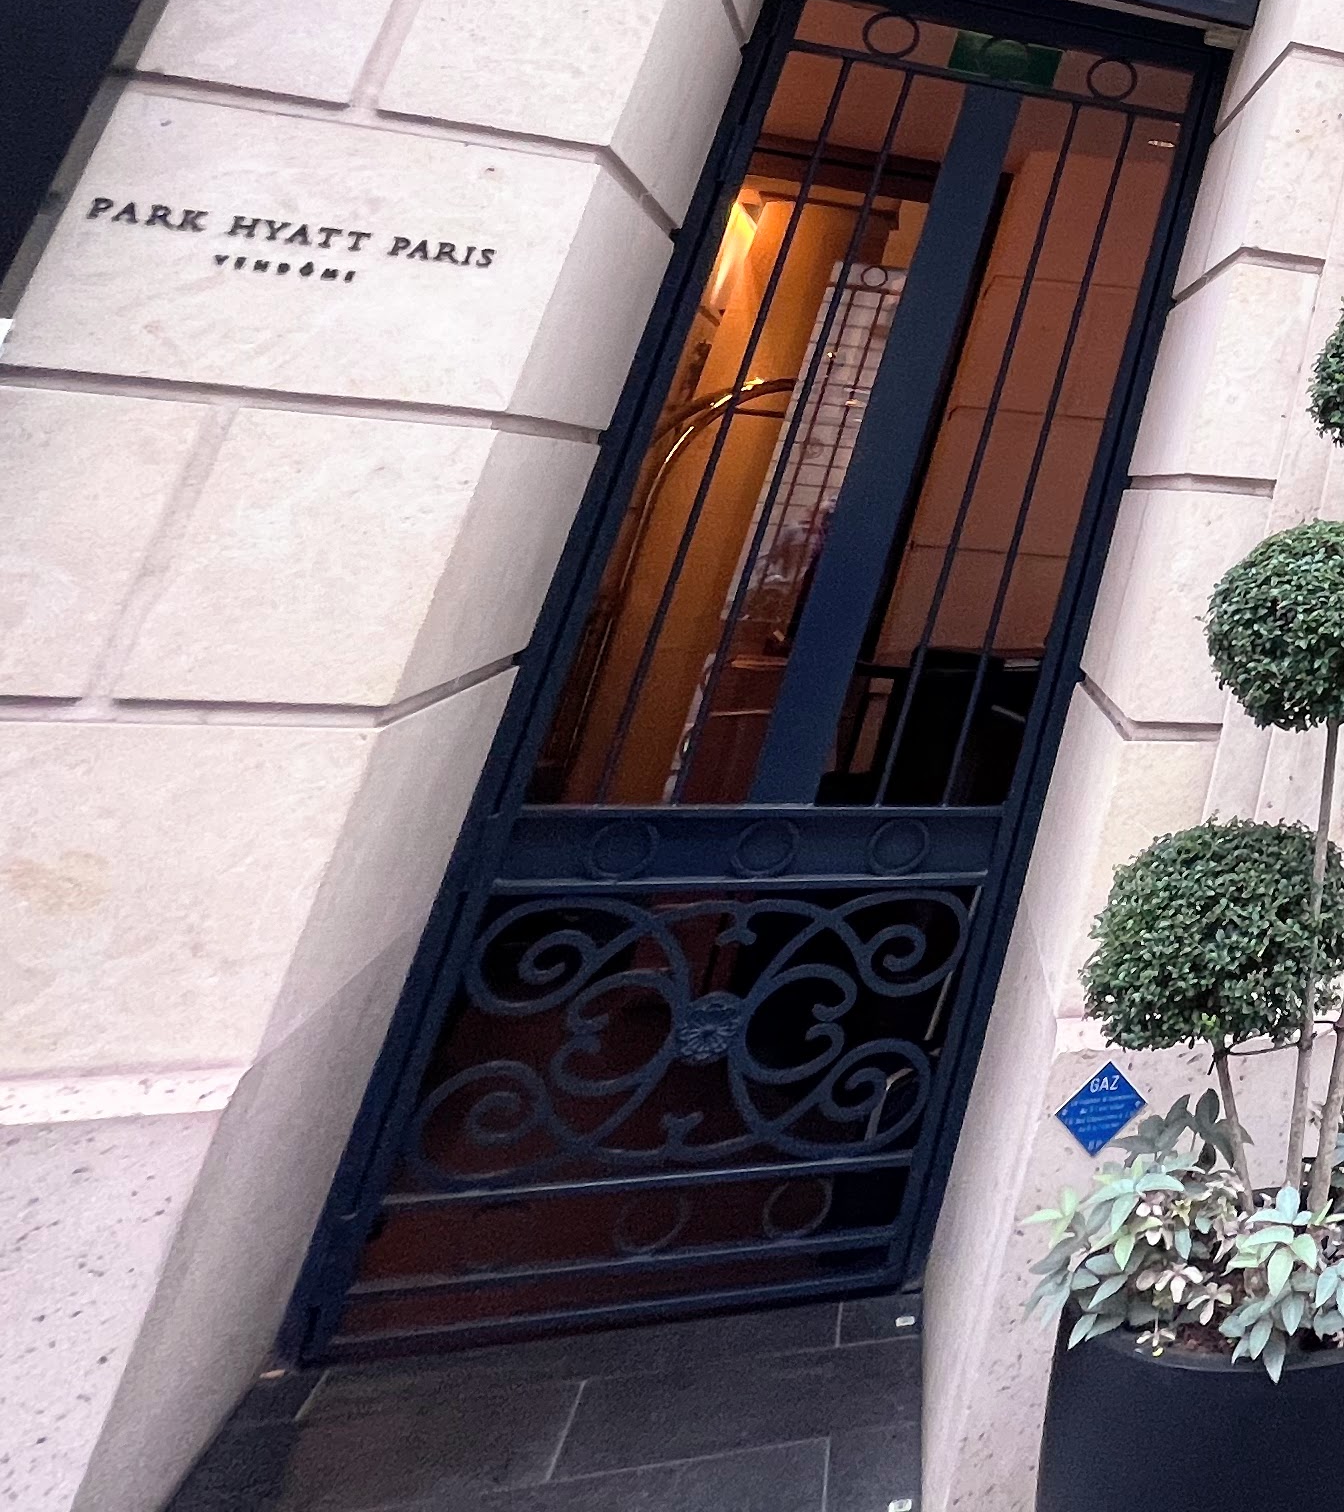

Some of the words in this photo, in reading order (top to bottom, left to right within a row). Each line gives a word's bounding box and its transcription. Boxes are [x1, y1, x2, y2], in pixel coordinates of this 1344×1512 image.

[85, 197, 210, 233] PARK
[227, 215, 373, 252] HYATT
[387, 235, 497, 269] PARIS
[1089, 1074, 1120, 1094] GAZ
